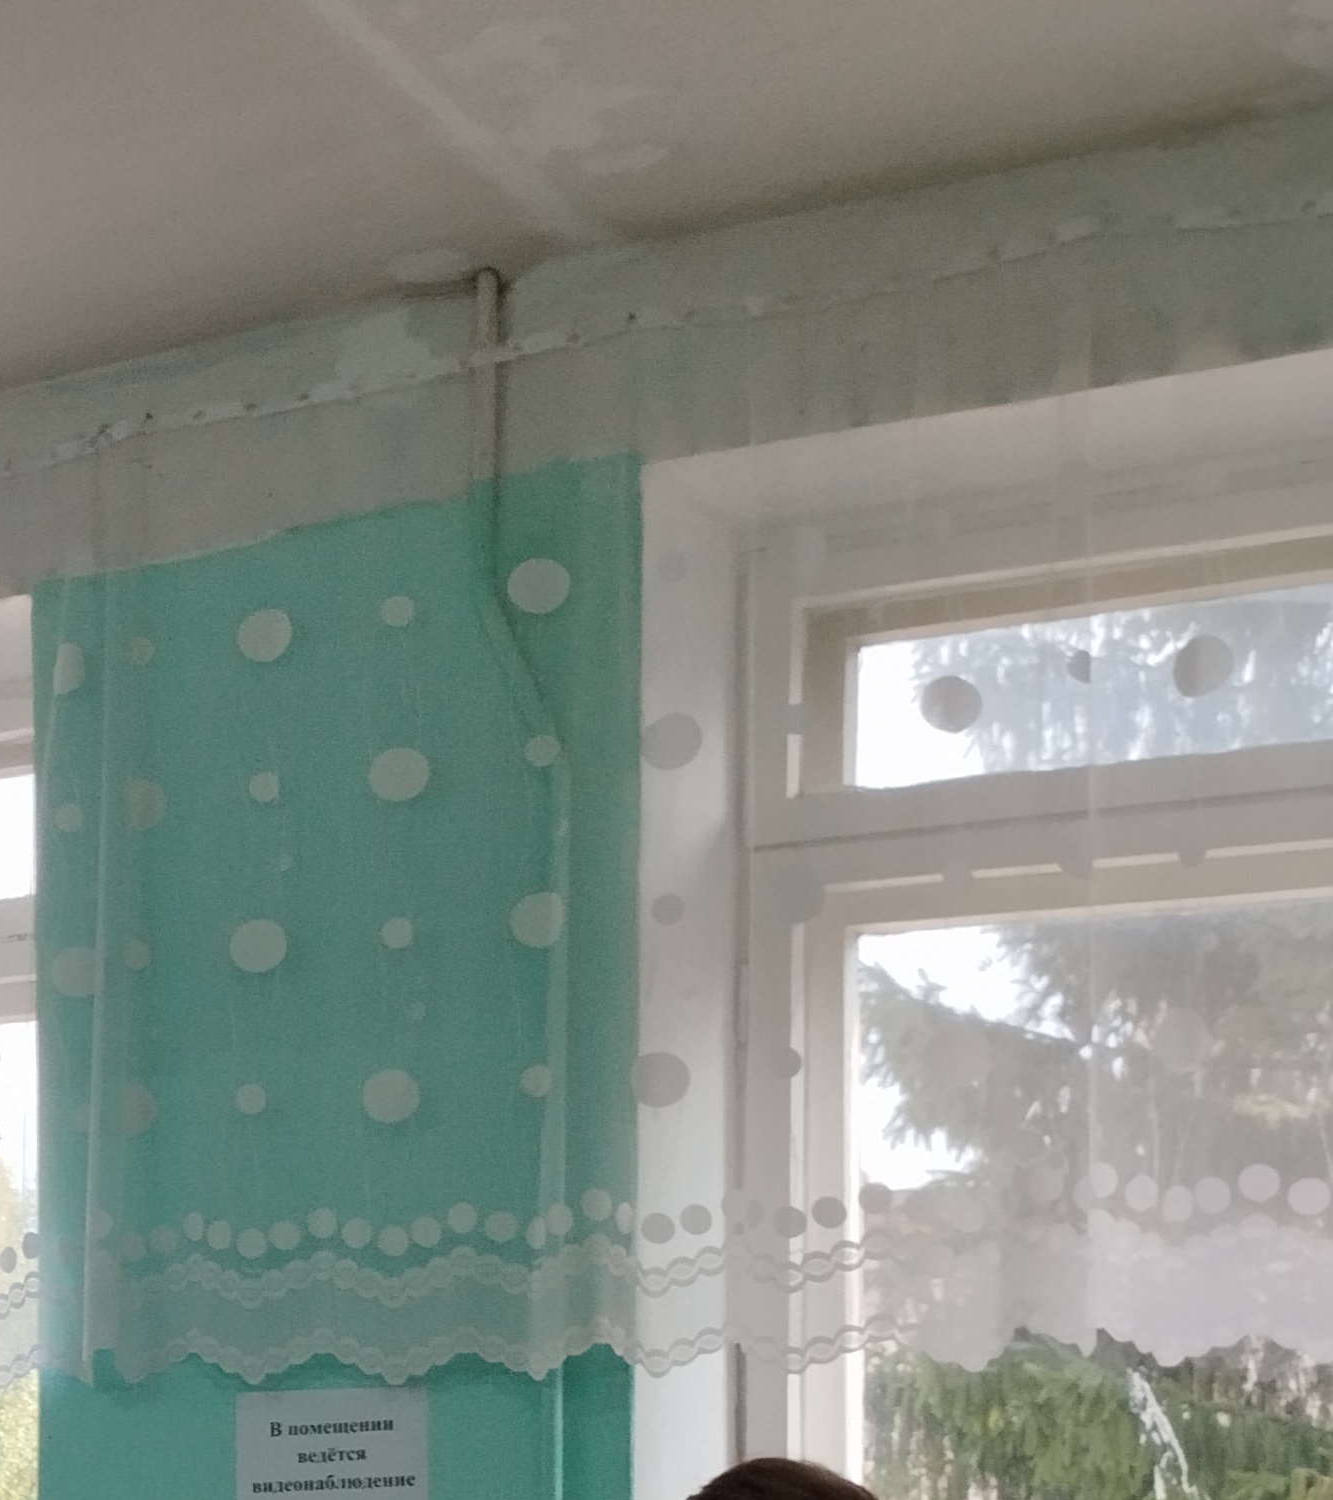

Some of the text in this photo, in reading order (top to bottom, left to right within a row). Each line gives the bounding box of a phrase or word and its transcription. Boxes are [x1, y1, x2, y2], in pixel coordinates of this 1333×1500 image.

[269, 1419, 395, 1438] В помещении
[297, 1447, 368, 1464] ведётся
[251, 1474, 417, 1494] видеонаблюдение
